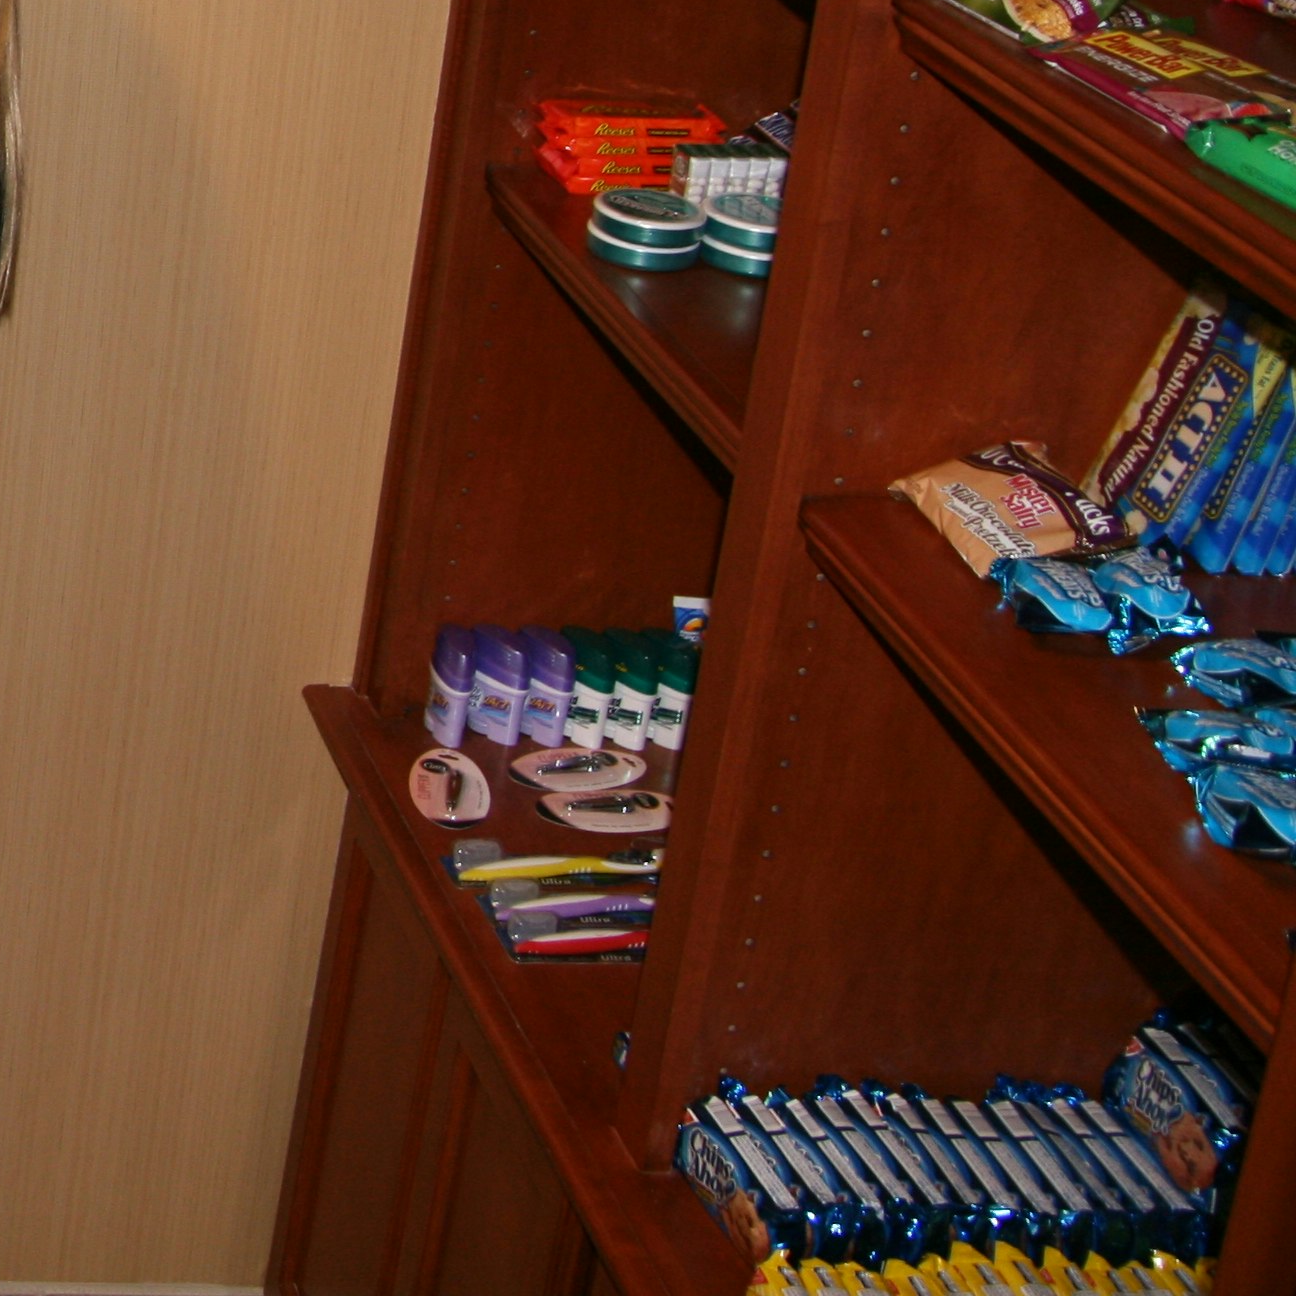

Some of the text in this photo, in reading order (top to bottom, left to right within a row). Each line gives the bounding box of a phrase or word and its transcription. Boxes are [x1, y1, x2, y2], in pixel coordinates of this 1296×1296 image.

[1093, 33, 1191, 74] PowerBar
[1102, 318, 1215, 502] Old Fashioned Natural
[1175, 371, 1227, 454] ACT
[940, 482, 1037, 557] Milk Chocolate
[1000, 493, 1043, 529] Salty
[1006, 473, 1056, 515] Mister
